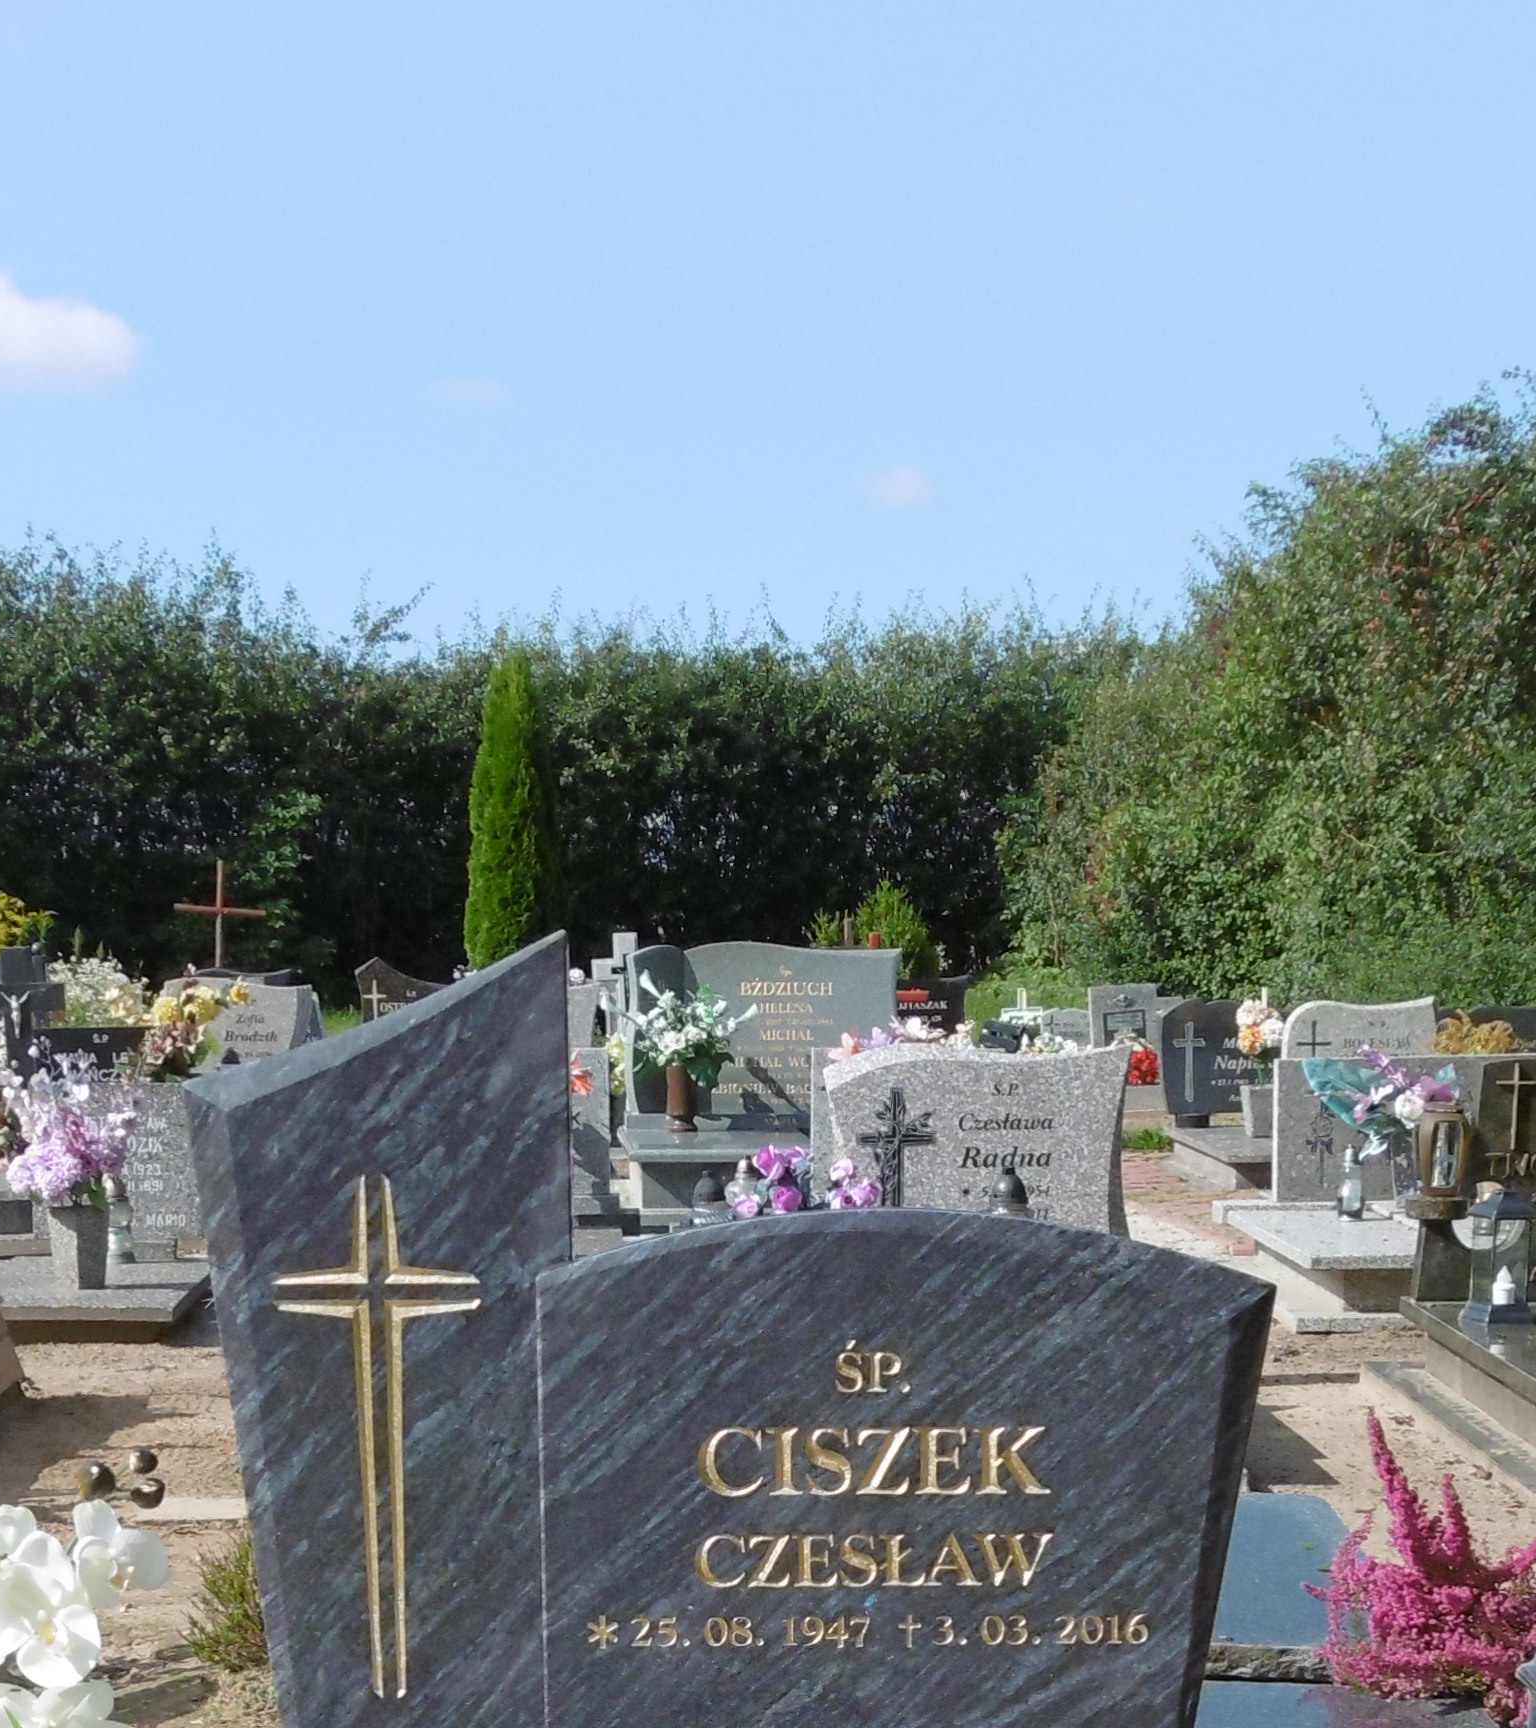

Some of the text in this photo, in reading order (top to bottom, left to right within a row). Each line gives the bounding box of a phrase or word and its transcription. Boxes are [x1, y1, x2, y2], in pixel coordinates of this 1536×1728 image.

[739, 977, 834, 996] BŻDZIUCH
[759, 1002, 814, 1014] HELENA
[223, 1029, 279, 1043] Brodzik
[958, 1112, 1055, 1132] Czesława
[958, 1145, 1054, 1169] Radna
[696, 1425, 1053, 1498] CISZEK
[693, 1531, 1055, 1590] CZESŁAW
[630, 1615, 692, 1648] 25.
[703, 1615, 765, 1649] 08.
[783, 1616, 871, 1649] 1947
[980, 1614, 1042, 1647] 03.
[1054, 1613, 1150, 1647] 2016
